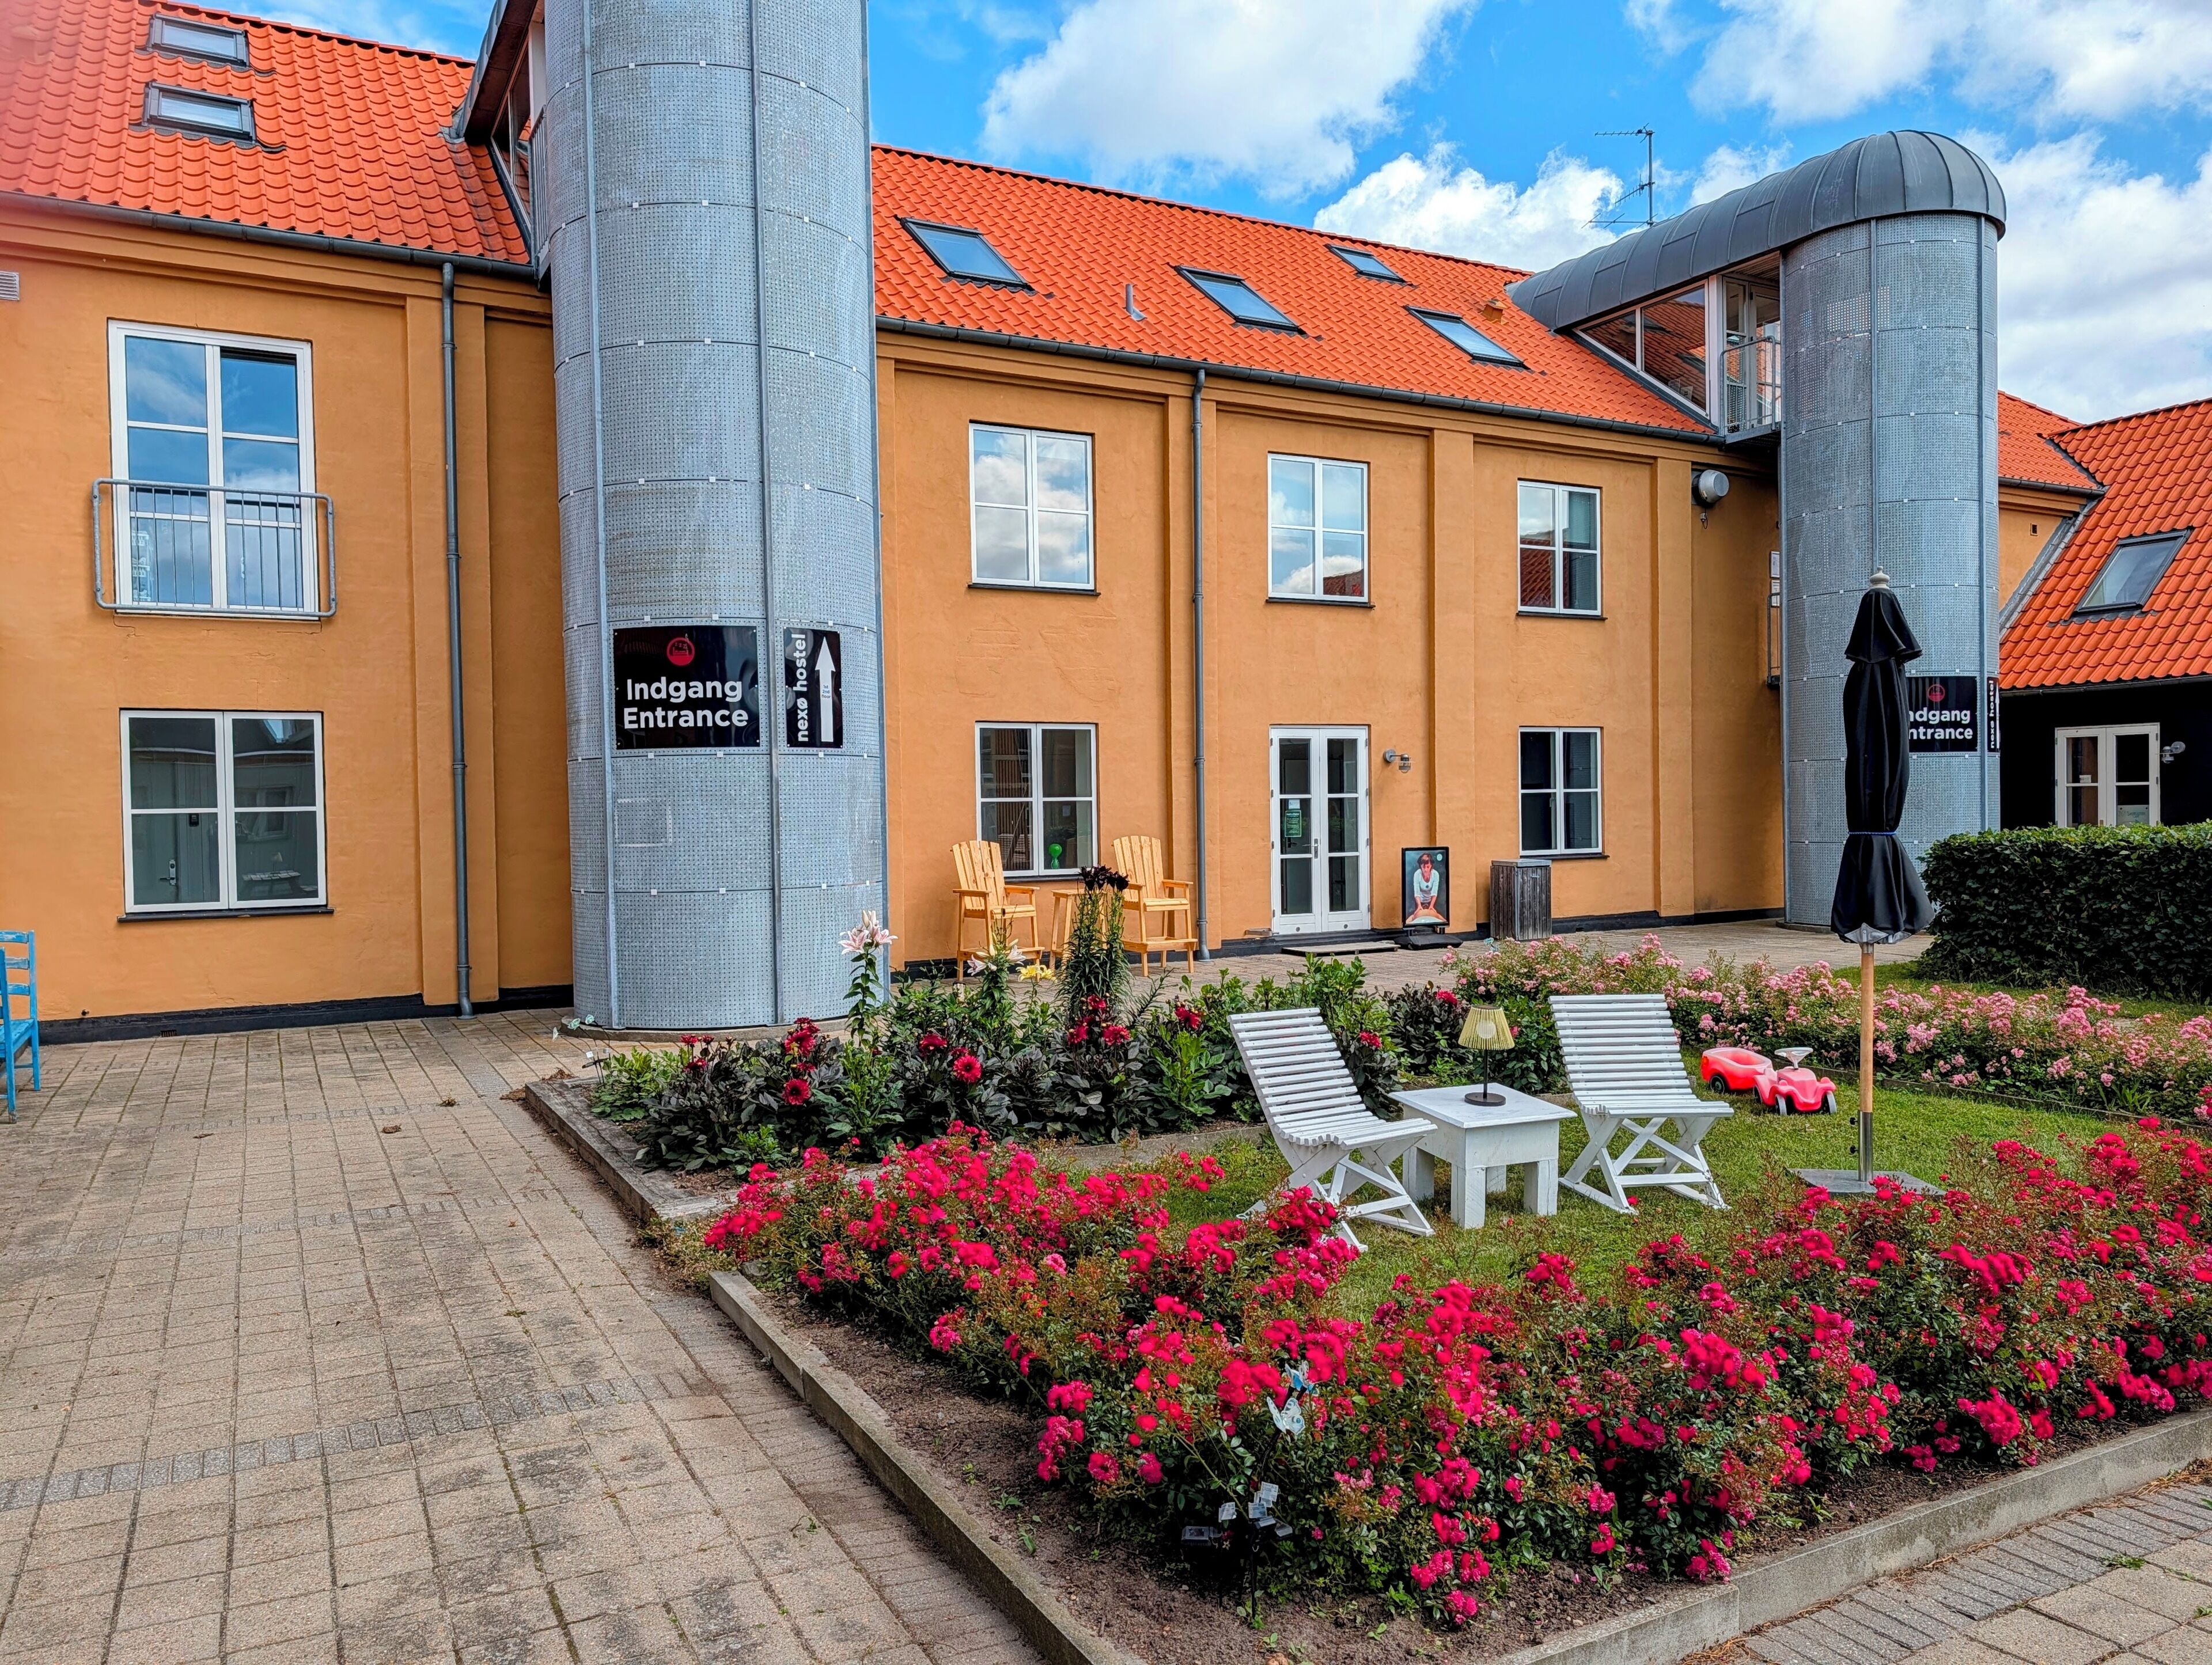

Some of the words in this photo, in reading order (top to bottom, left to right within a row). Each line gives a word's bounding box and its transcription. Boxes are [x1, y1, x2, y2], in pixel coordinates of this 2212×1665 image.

[791, 634, 808, 691] hostel
[627, 676, 742, 703] Indgang
[624, 707, 748, 730] Entrance
[797, 697, 809, 742] nexø
[1909, 707, 1971, 725] ndgang
[1908, 726, 1973, 739] ntrance
